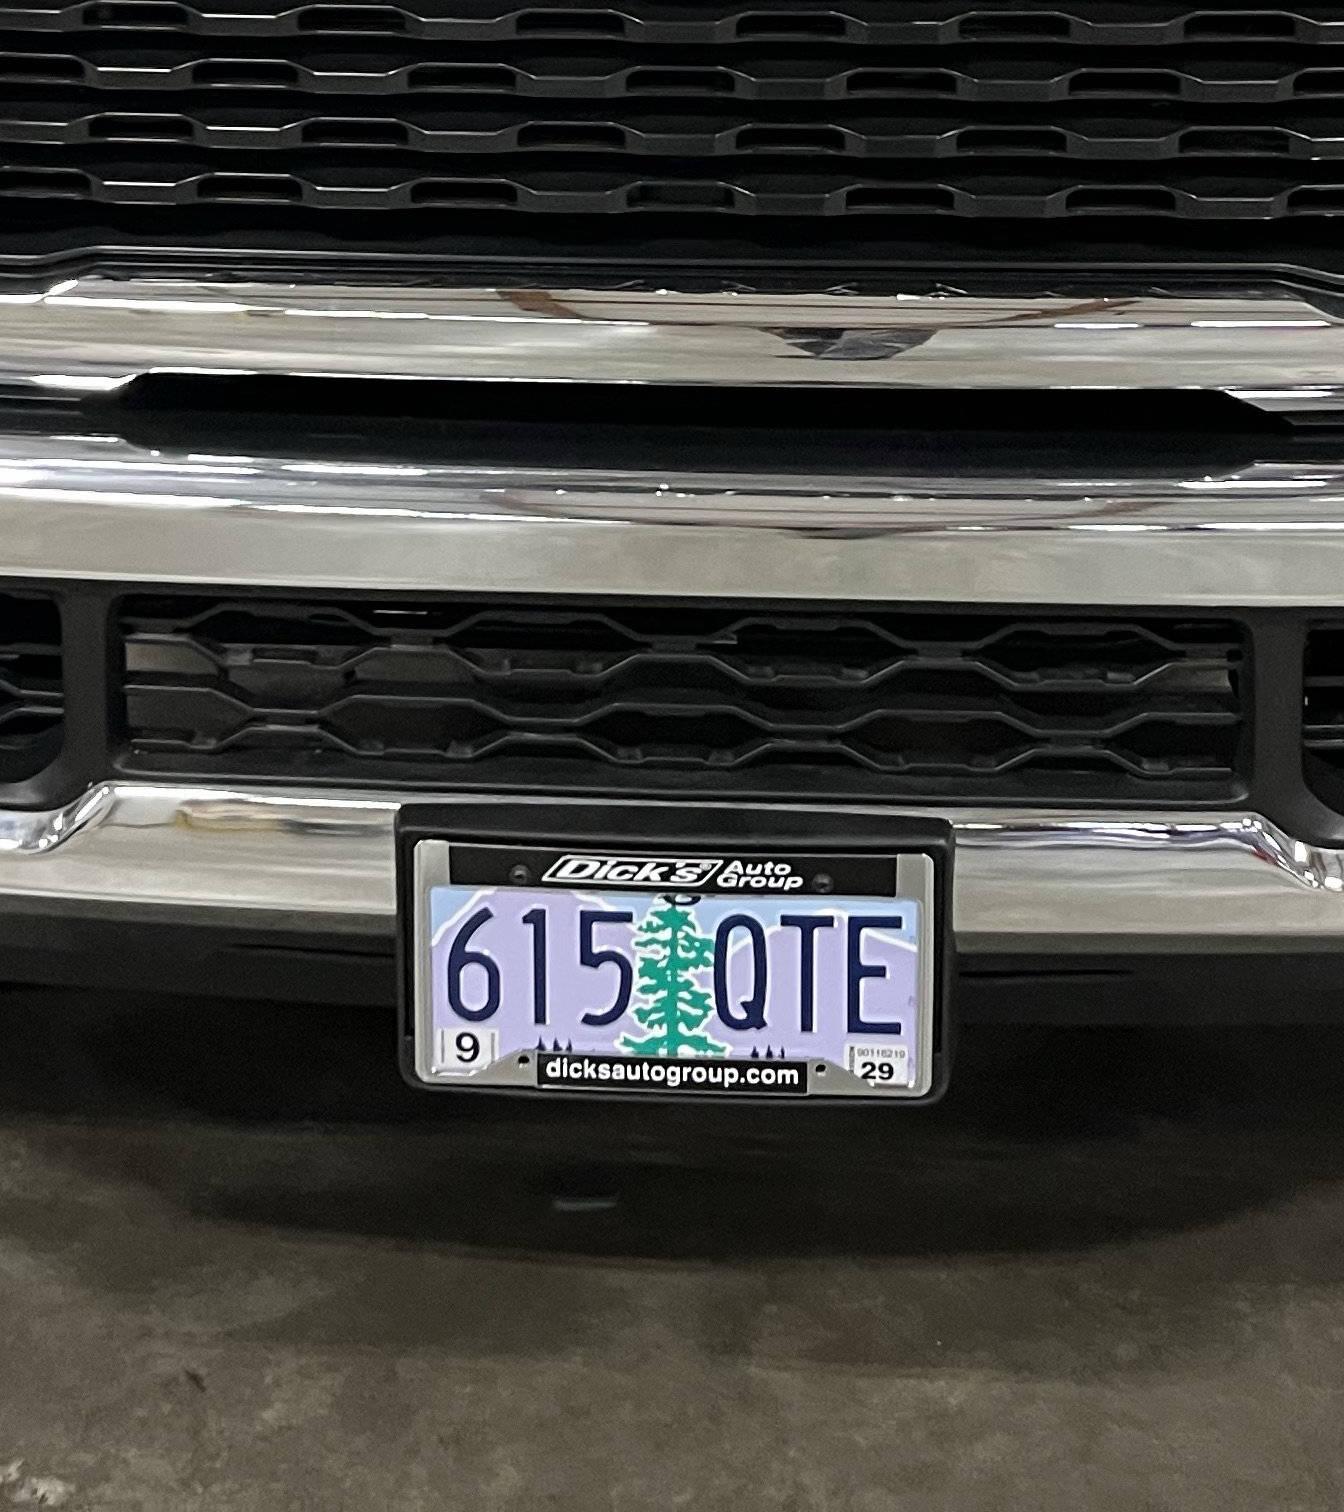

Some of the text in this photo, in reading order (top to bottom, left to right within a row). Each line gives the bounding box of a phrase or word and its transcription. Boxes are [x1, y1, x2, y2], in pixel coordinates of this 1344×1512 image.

[556, 858, 703, 883] Dick's
[723, 860, 792, 876] Auto
[716, 874, 804, 890] Group
[447, 906, 903, 1035] 615 QTE
[455, 1032, 481, 1063] 9
[545, 1060, 799, 1088] dicksautogroup.com
[861, 1061, 894, 1081] 29
